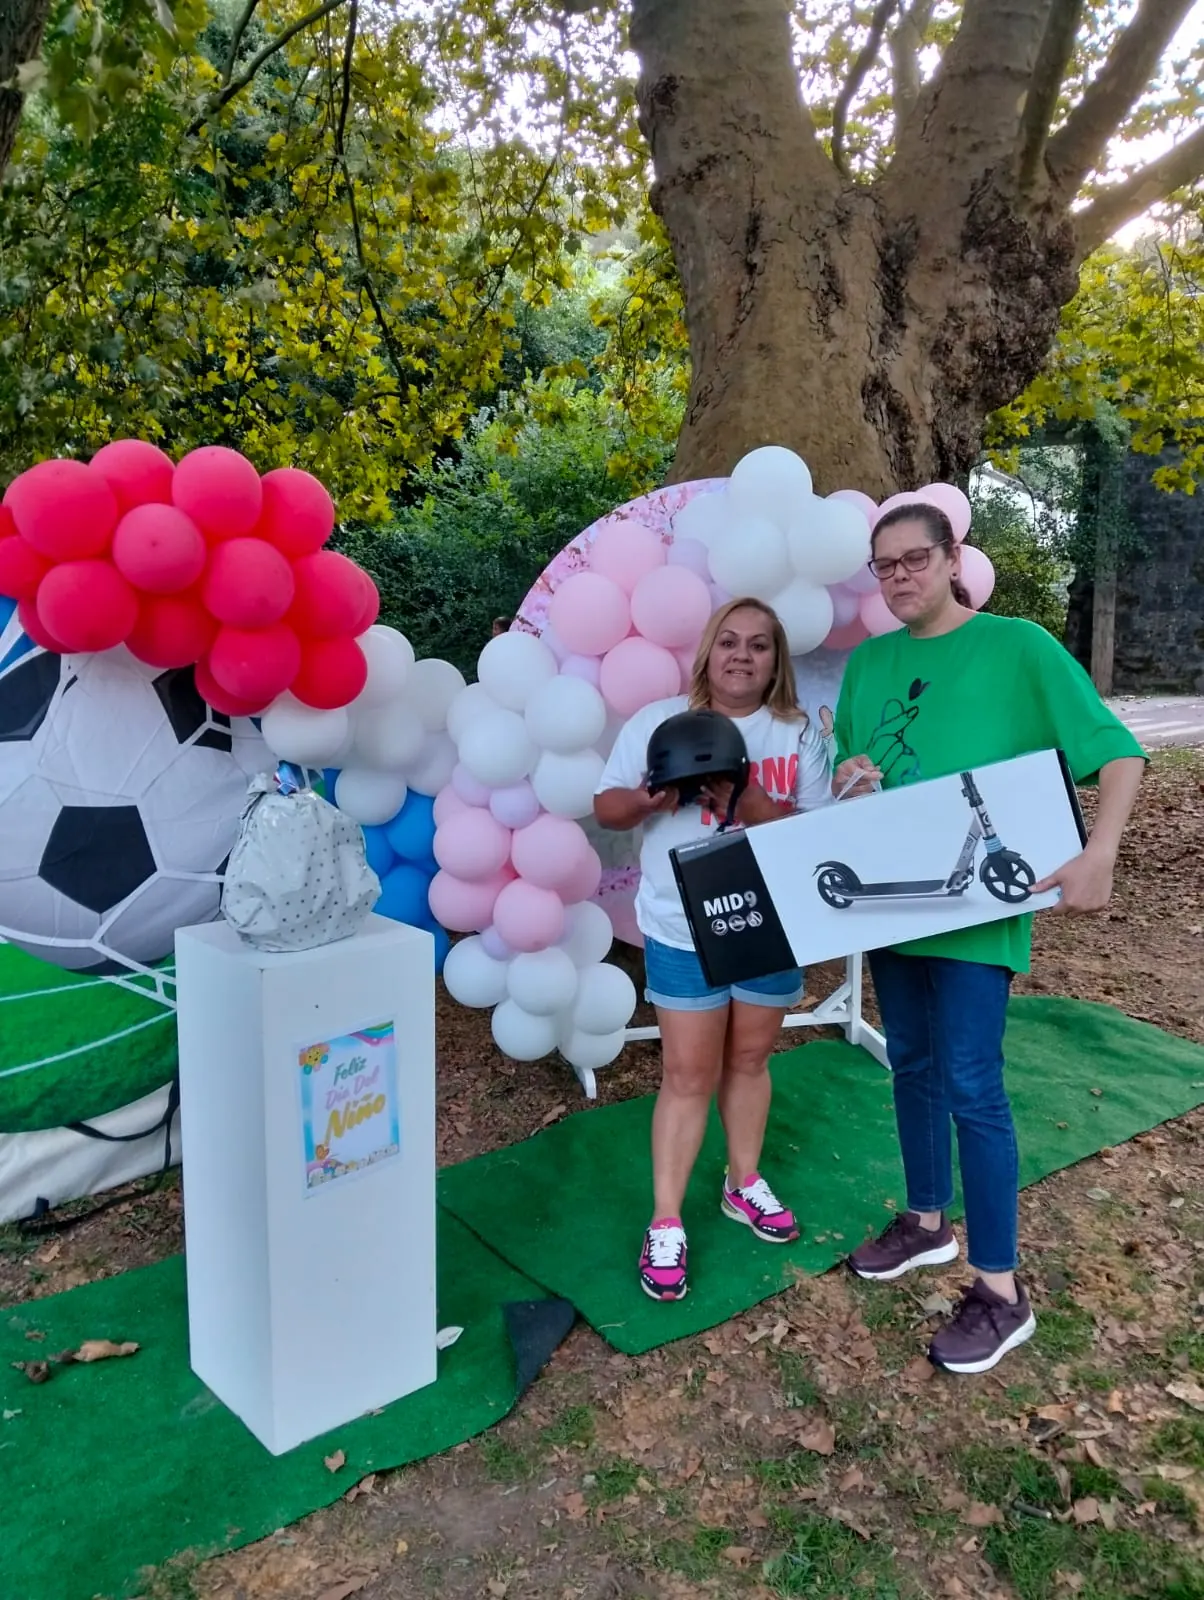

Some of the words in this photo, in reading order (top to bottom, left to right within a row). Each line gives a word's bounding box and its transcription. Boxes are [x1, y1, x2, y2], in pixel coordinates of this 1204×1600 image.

[703, 890, 757, 917] MID9
[334, 1056, 367, 1086] Feliz
[354, 1065, 380, 1095] Del
[324, 1092, 386, 1146] Niño
